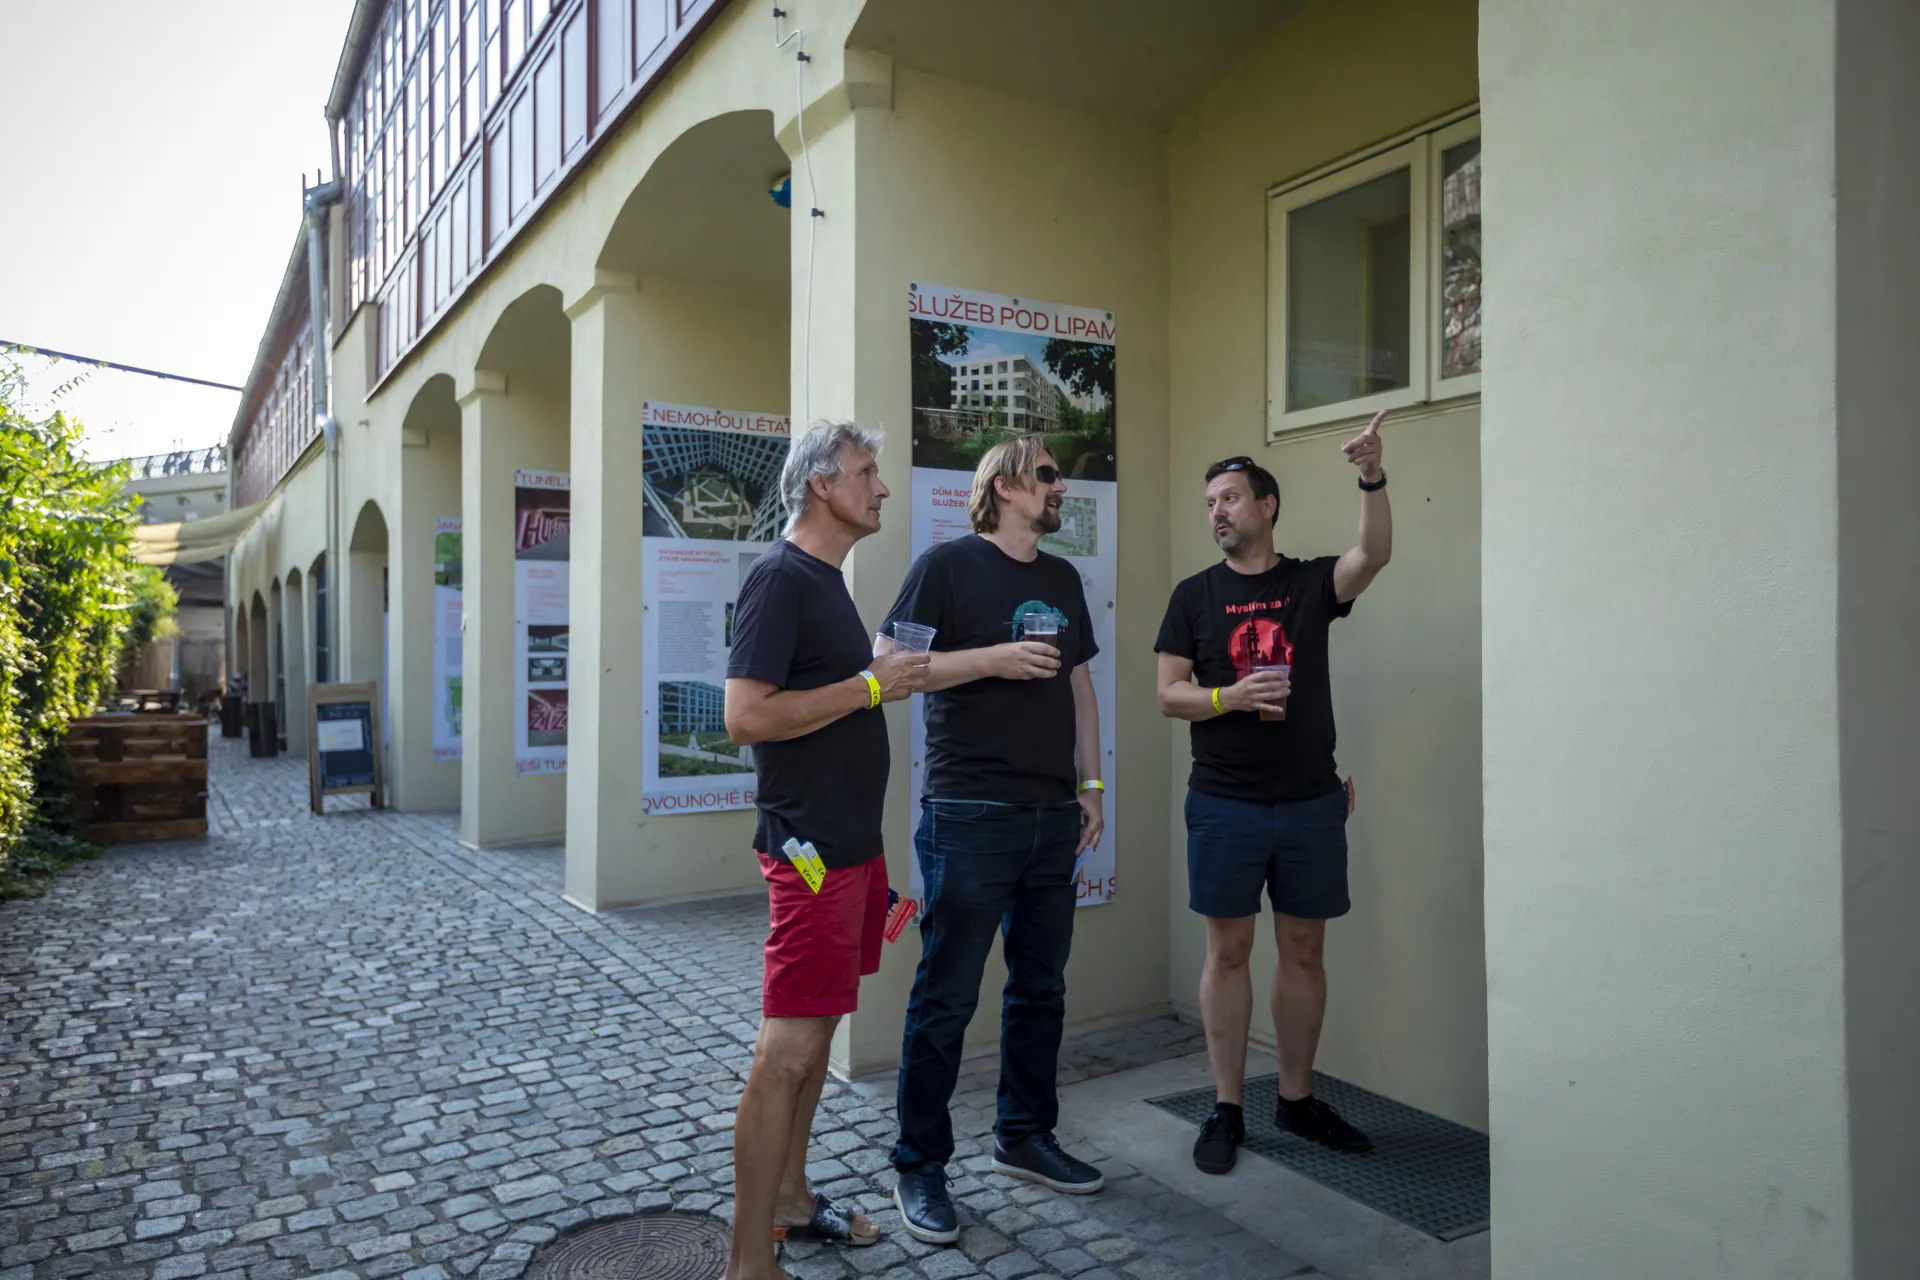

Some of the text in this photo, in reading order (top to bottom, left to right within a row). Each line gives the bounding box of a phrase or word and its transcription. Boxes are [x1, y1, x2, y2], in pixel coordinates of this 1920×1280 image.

[908, 291, 1115, 340] SLUŽEB POD LIPAM
[653, 408, 743, 429] NEMOHOU
[521, 474, 565, 487] TUNEL
[932, 486, 952, 496] DŮM
[932, 498, 965, 508] SLUŽEB
[1225, 601, 1267, 614] Myslím
